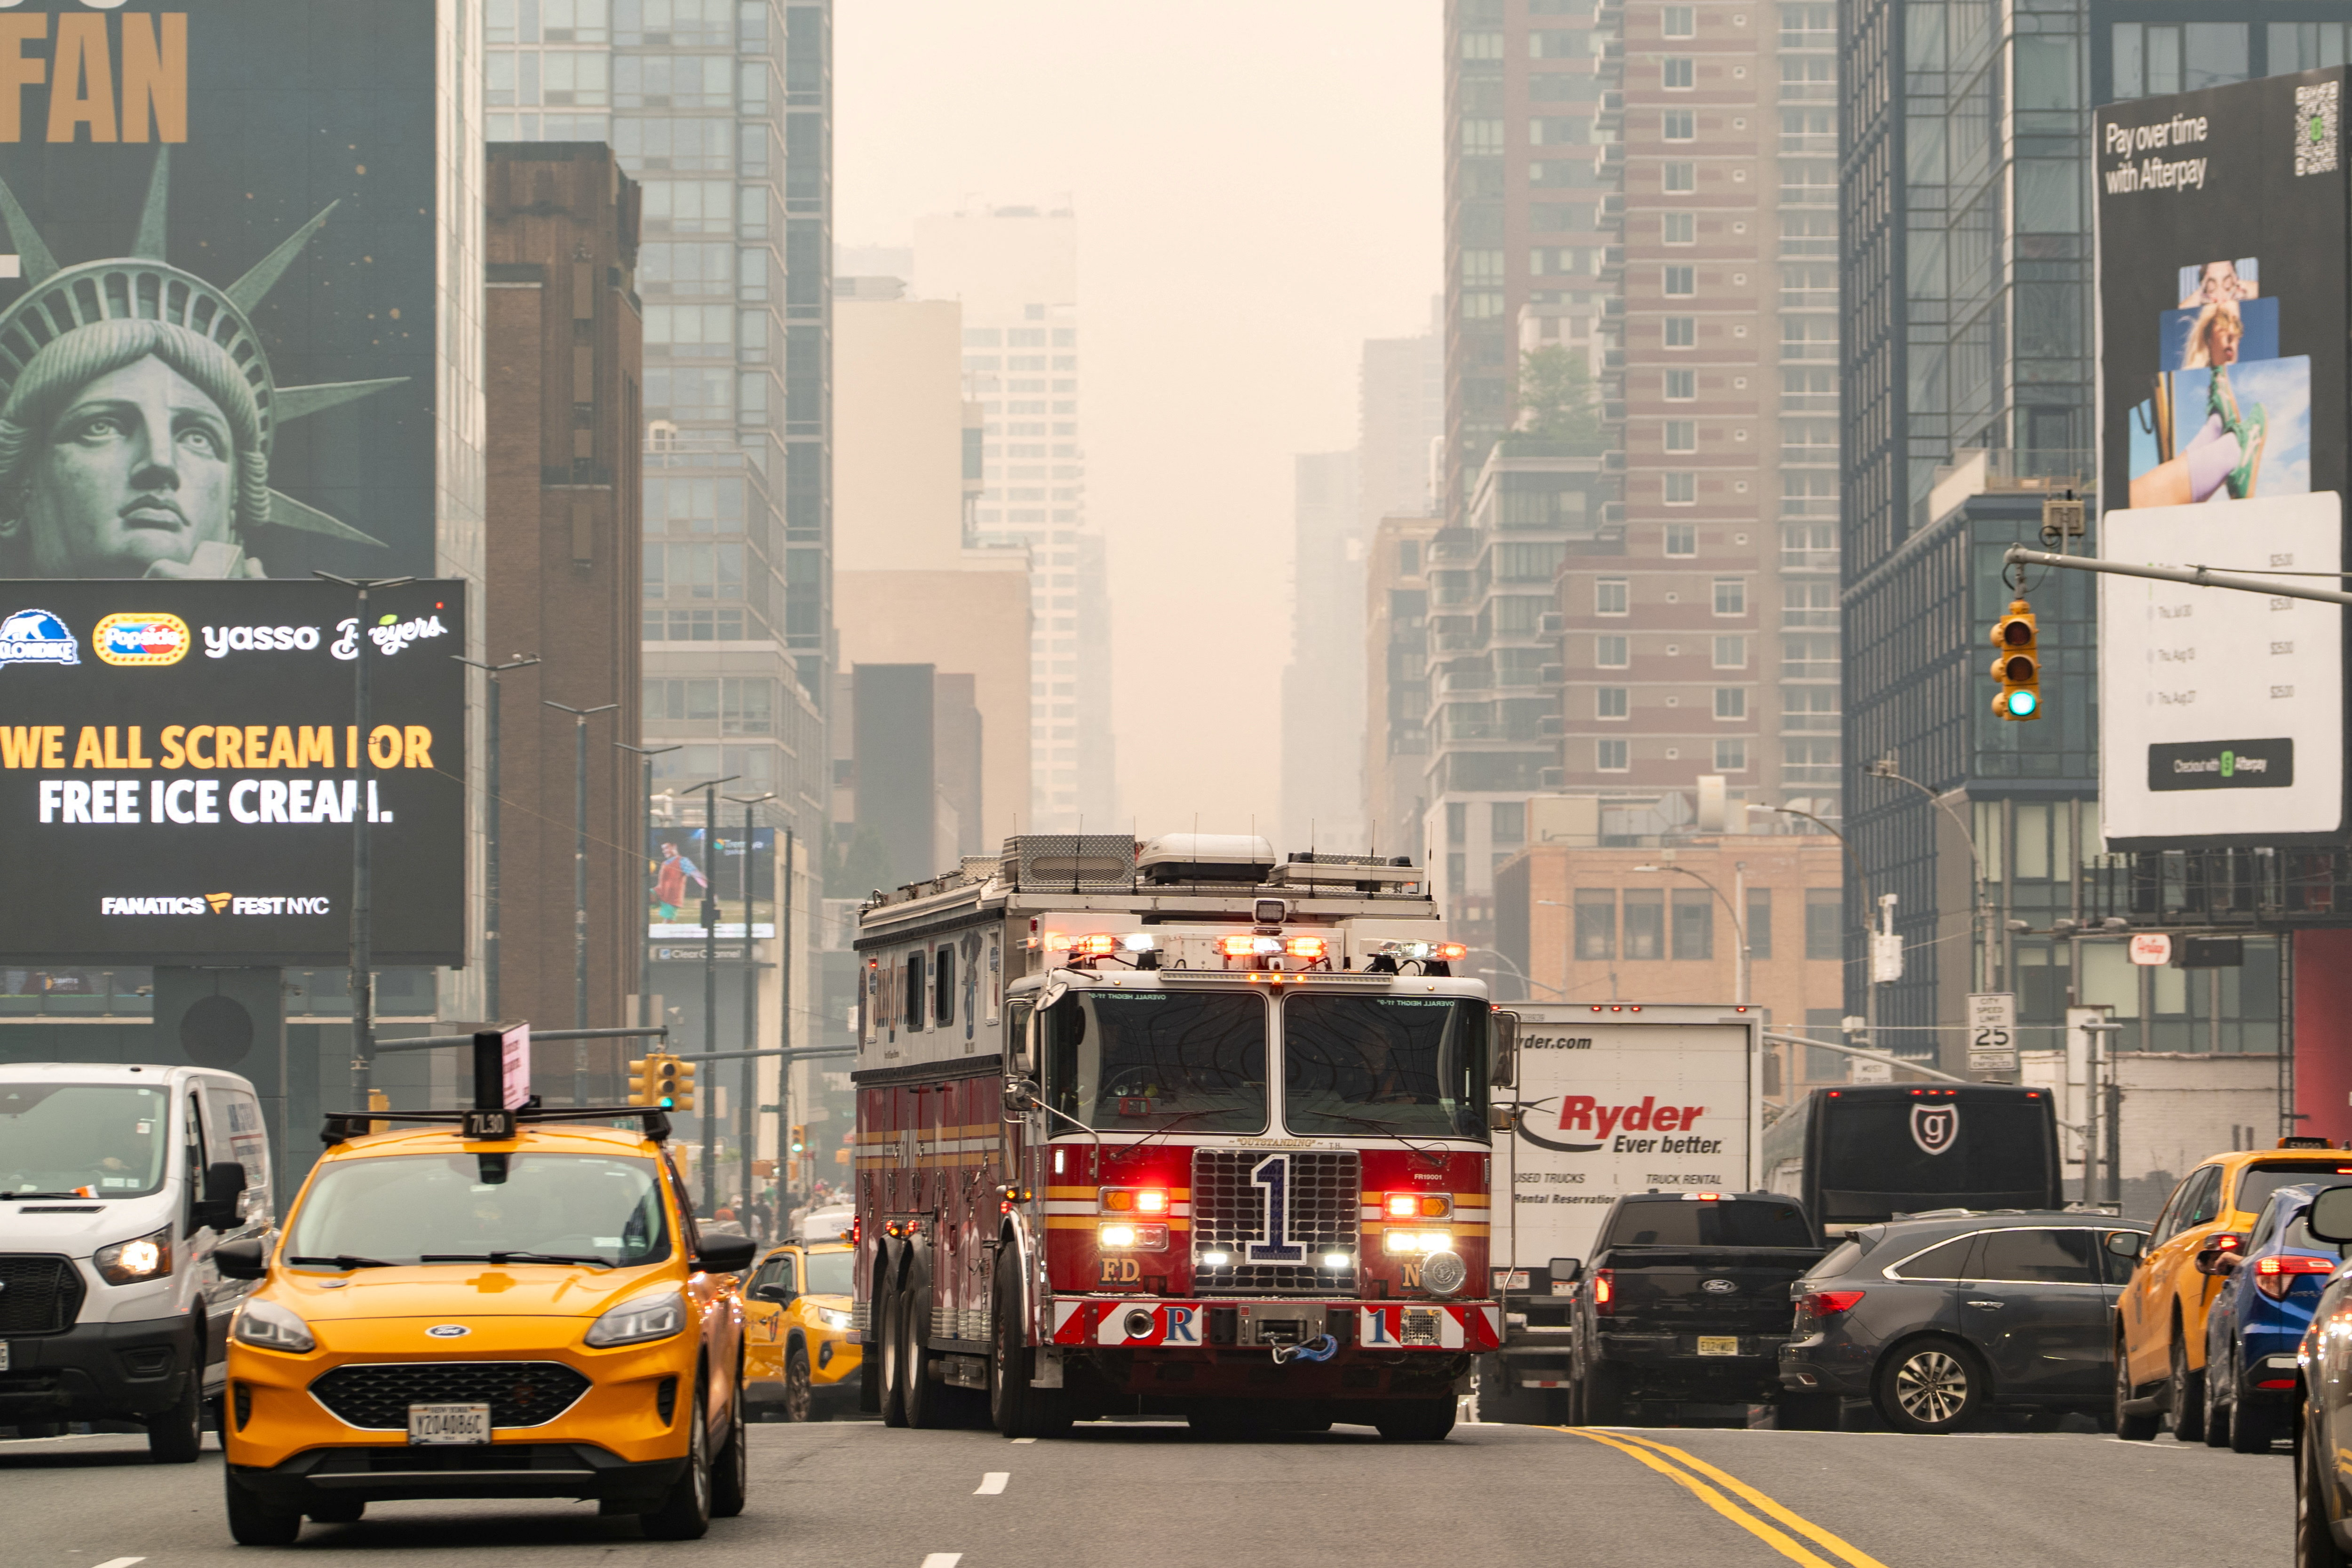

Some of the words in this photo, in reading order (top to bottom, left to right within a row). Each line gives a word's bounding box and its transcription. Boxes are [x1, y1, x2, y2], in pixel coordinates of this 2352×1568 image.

[0, 12, 187, 143] FAN
[2106, 122, 2135, 160] Pay
[2136, 123, 2171, 151] over
[2172, 113, 2208, 145] time
[2106, 160, 2138, 194] with
[2140, 157, 2208, 192] Afterpay
[201, 626, 320, 659] yasso
[331, 616, 448, 660] Beyers
[0, 726, 65, 768] WE
[73, 726, 152, 768] ALL
[160, 725, 335, 769] SCREAM
[2235, 756, 2267, 772] Afterpay
[40, 780, 141, 823] FREE
[151, 780, 220, 823] ICE
[229, 780, 394, 823] CREAM.
[102, 897, 206, 915] FANATICS
[232, 897, 285, 915] FEST
[286, 897, 329, 915] NYC
[671, 950, 698, 958] Clear
[699, 949, 741, 958] Cannel
[1514, 1035, 1592, 1050] yder.com
[1975, 1026, 2009, 1045] 25
[470, 1114, 505, 1134] 7L30
[1558, 1095, 1704, 1139] Ryder
[1923, 1115, 1947, 1143] g
[1613, 1135, 1658, 1153] Ever
[1661, 1135, 1722, 1154] better.
[1515, 1173, 1541, 1183] USED
[1544, 1173, 1586, 1183] TRUCKS
[1646, 1174, 1681, 1184] TRUCK
[1683, 1175, 1722, 1184] RENTAL
[1245, 1154, 1307, 1266] 1
[1515, 1194, 1549, 1203] Rental
[1101, 1258, 1141, 1282] F.D.
[1163, 1306, 1199, 1342] R
[1367, 1308, 1392, 1345] 1
